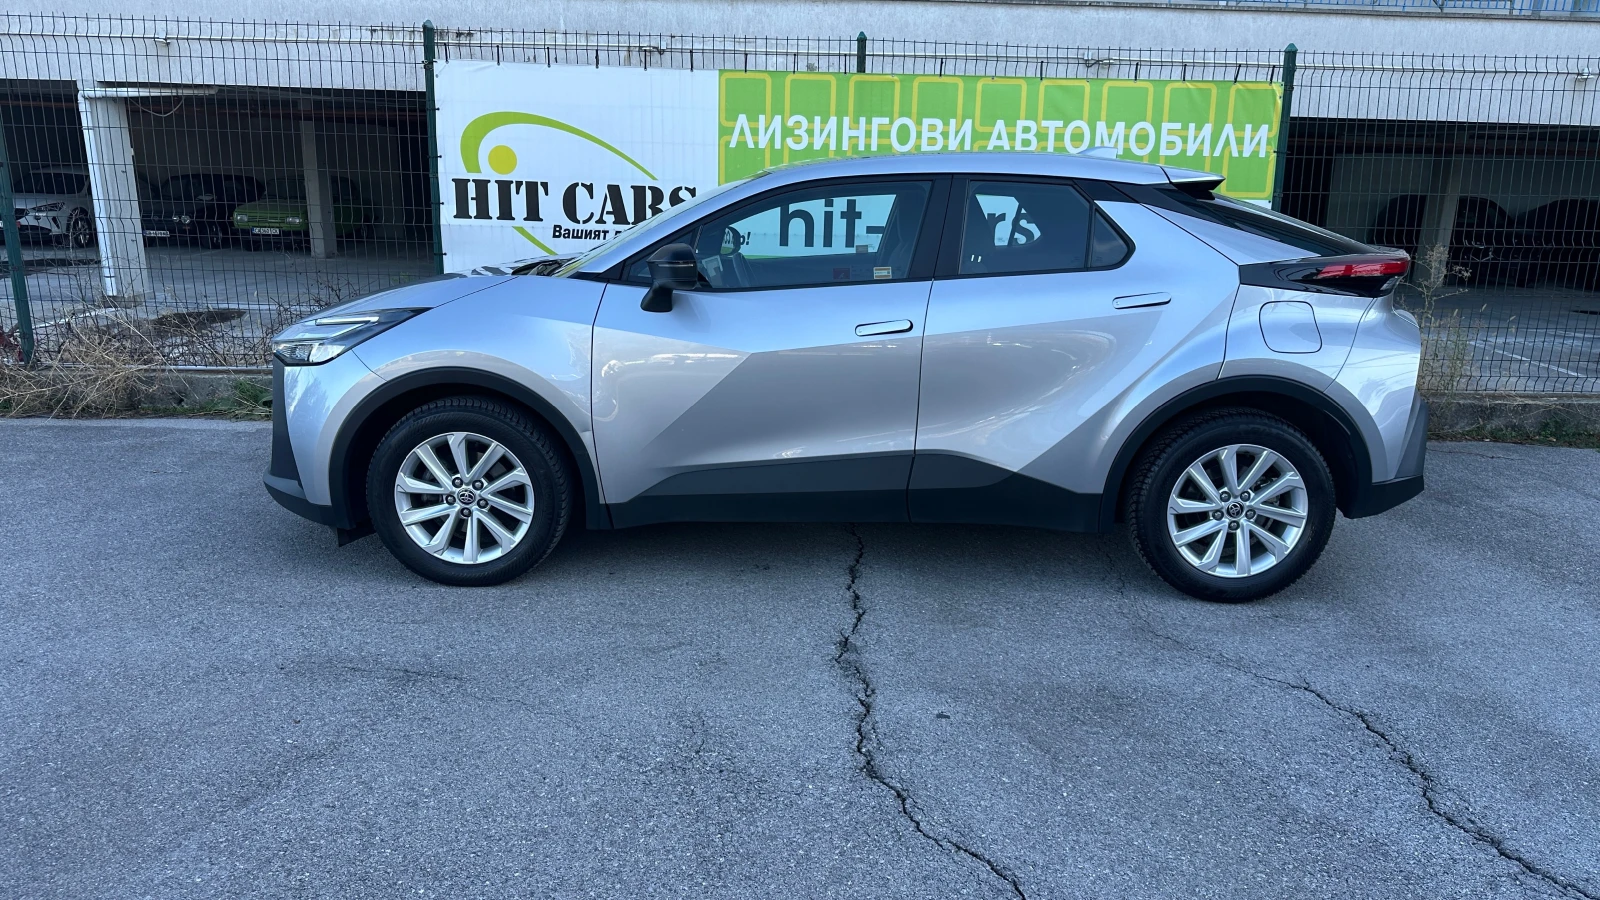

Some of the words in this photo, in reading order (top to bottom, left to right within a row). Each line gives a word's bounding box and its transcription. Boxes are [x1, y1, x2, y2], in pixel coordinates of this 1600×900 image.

[729, 113, 973, 153] ЛИЗИНГОВИ
[987, 119, 1269, 158] АВТОМОБИЛИ
[451, 178, 549, 222] HIT
[552, 224, 609, 241] Вашият
